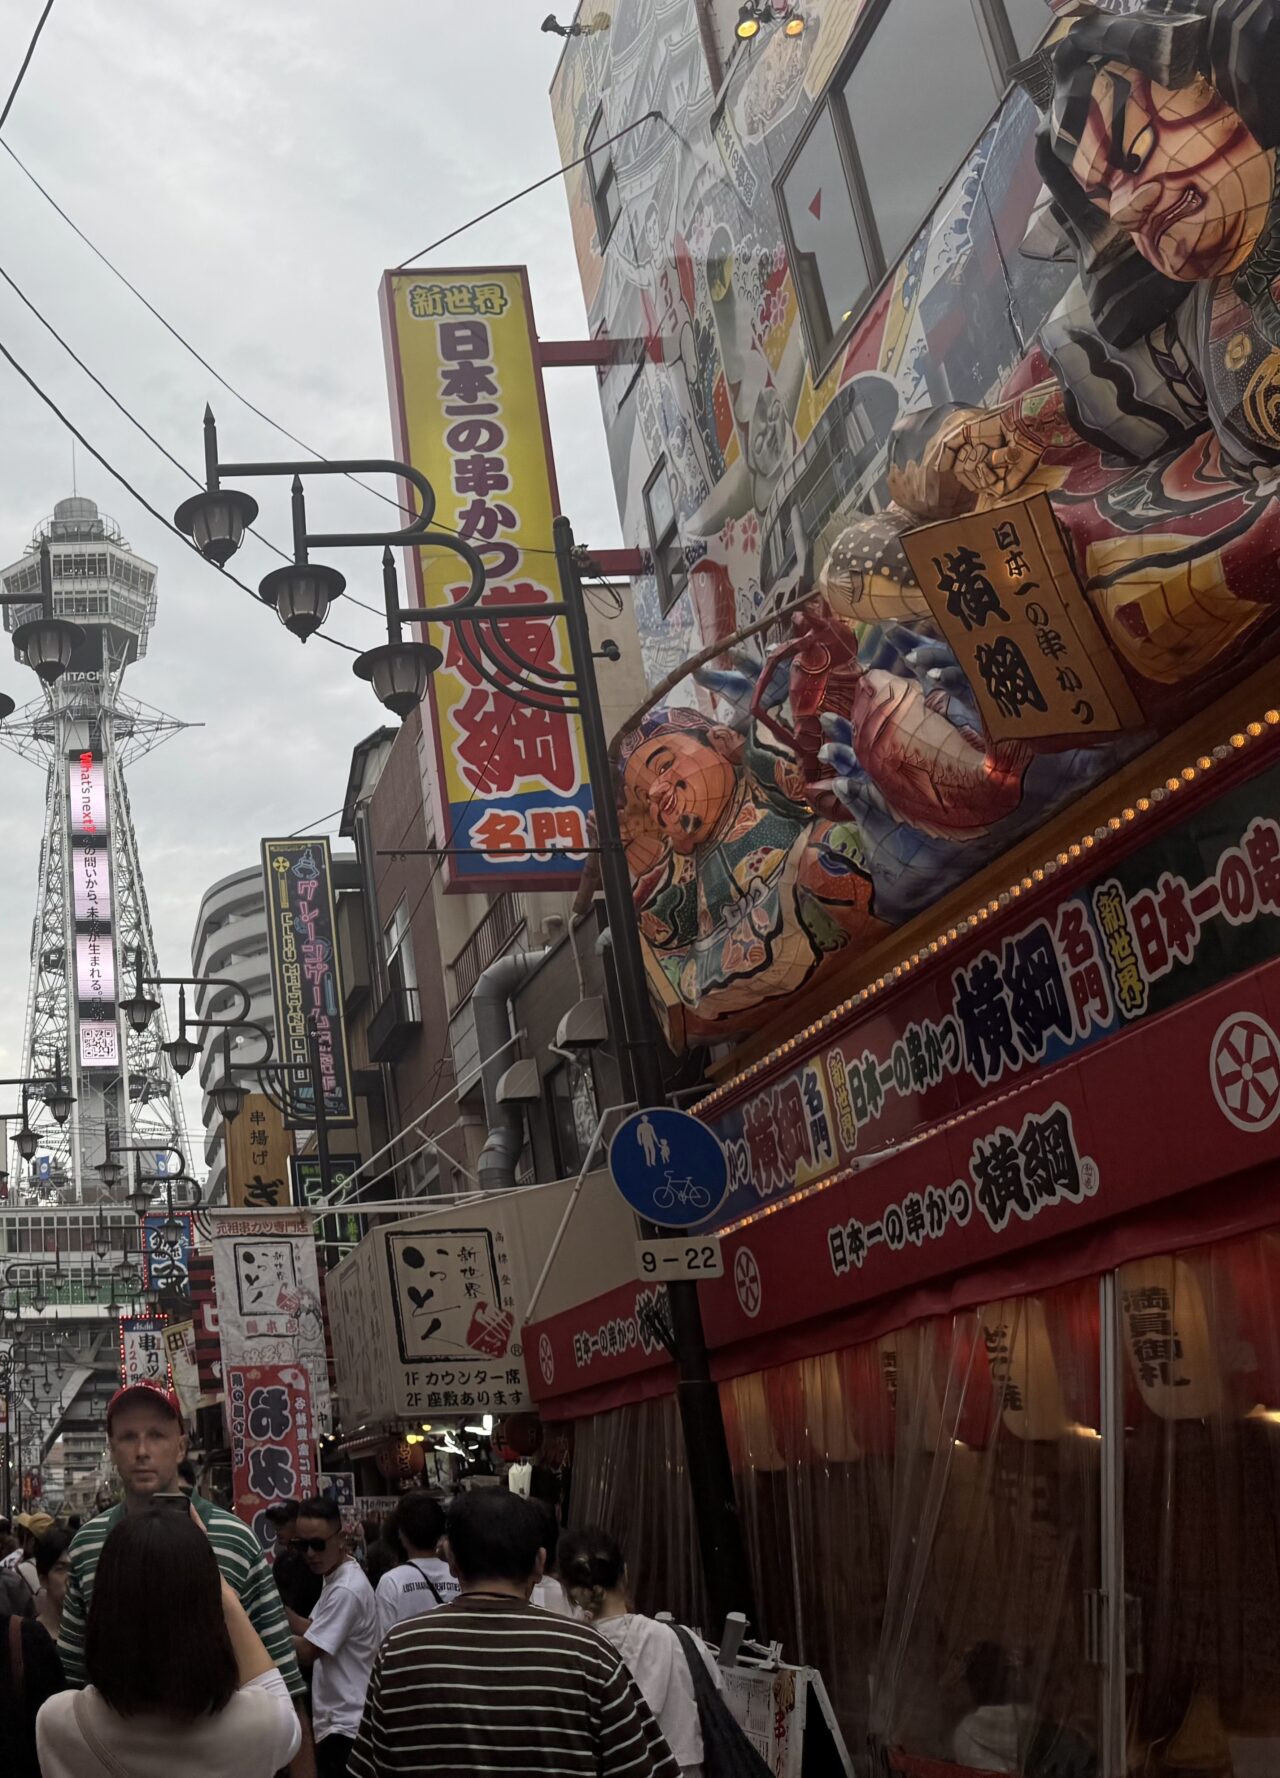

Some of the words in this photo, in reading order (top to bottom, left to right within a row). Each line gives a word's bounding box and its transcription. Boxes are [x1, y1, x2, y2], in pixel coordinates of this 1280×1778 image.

[410, 283, 507, 319] 新世界
[439, 321, 518, 579] 日本一の串かつ
[445, 586, 575, 794] 横綱
[79, 751, 94, 794] What's
[81, 795, 97, 834] next?
[476, 808, 587, 861] 名門
[82, 838, 103, 996] の問いから、未が生まれる。
[1096, 885, 1146, 1014] 新世界
[956, 921, 1072, 1082] 横綱
[1058, 904, 1112, 1040] 名門
[830, 1052, 856, 1150] 新世界
[848, 1018, 960, 1122] 日本一の串かつ
[249, 1110, 269, 1166] 串揚げ
[743, 1080, 812, 1195] 横綱
[802, 1067, 834, 1161] 名門
[972, 1108, 1079, 1228] 横綱
[216, 1221, 309, 1236] 元祖串カツ専門店
[830, 1188, 970, 1273] 日本一の串かつ
[457, 1247, 485, 1299] 新世界
[138, 1332, 159, 1379] 串カツ
[576, 1318, 636, 1366] 日本一の串かつ
[405, 1372, 420, 1387] 1F
[425, 1369, 520, 1387] カウンター席
[406, 1393, 421, 1407] 2F
[427, 1390, 523, 1408] 座敷あります
[402, 1583, 416, 1593] LOST
